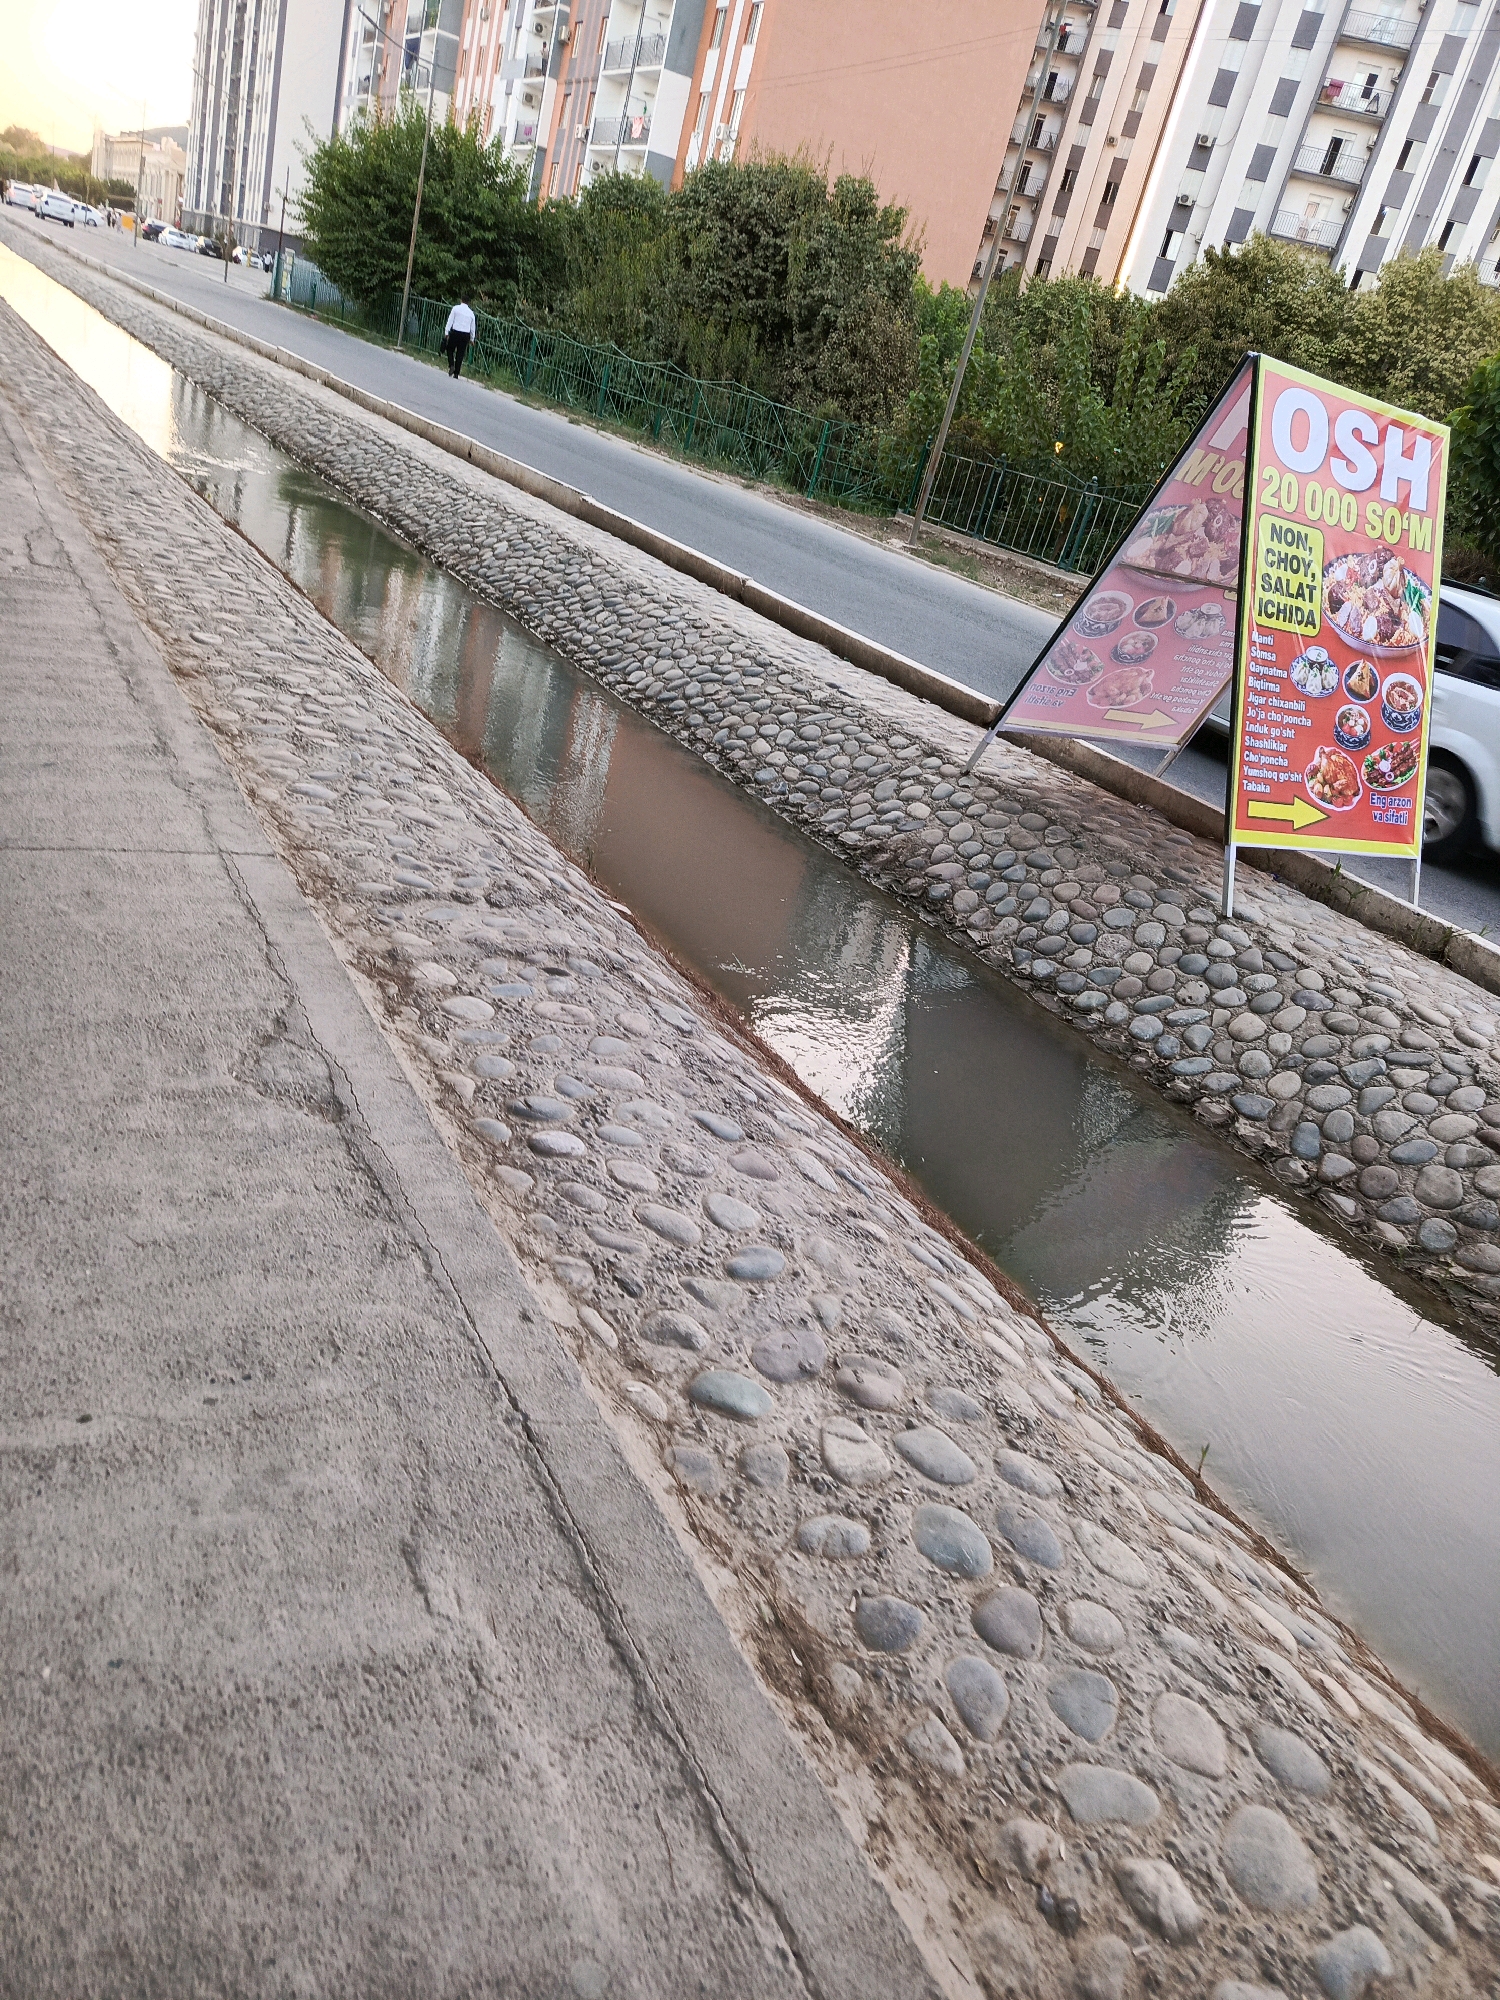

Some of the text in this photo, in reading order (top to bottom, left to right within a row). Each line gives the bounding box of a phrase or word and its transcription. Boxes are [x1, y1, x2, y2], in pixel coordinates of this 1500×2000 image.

[1271, 387, 1432, 511] OSH
[1260, 466, 1298, 513] 20
[1304, 481, 1357, 532] 000
[1270, 523, 1313, 556] NON,
[1264, 548, 1316, 582] CHOY,
[1261, 573, 1317, 604] SALAT
[1258, 598, 1317, 629] ICHIDA
[1251, 630, 1274, 645] Manti
[1250, 646, 1276, 661] Somsa
[1249, 661, 1288, 678] Qaynatma
[1247, 692, 1306, 711] Jigar chixanbili
[1245, 721, 1268, 734] Induk
[1244, 736, 1288, 752] Shashliklar
[1243, 765, 1278, 781] Yumshoq
[1242, 779, 1270, 793] Tabaka
[1370, 792, 1412, 808] Eng arzon
[1372, 809, 1408, 824] va sifatli
